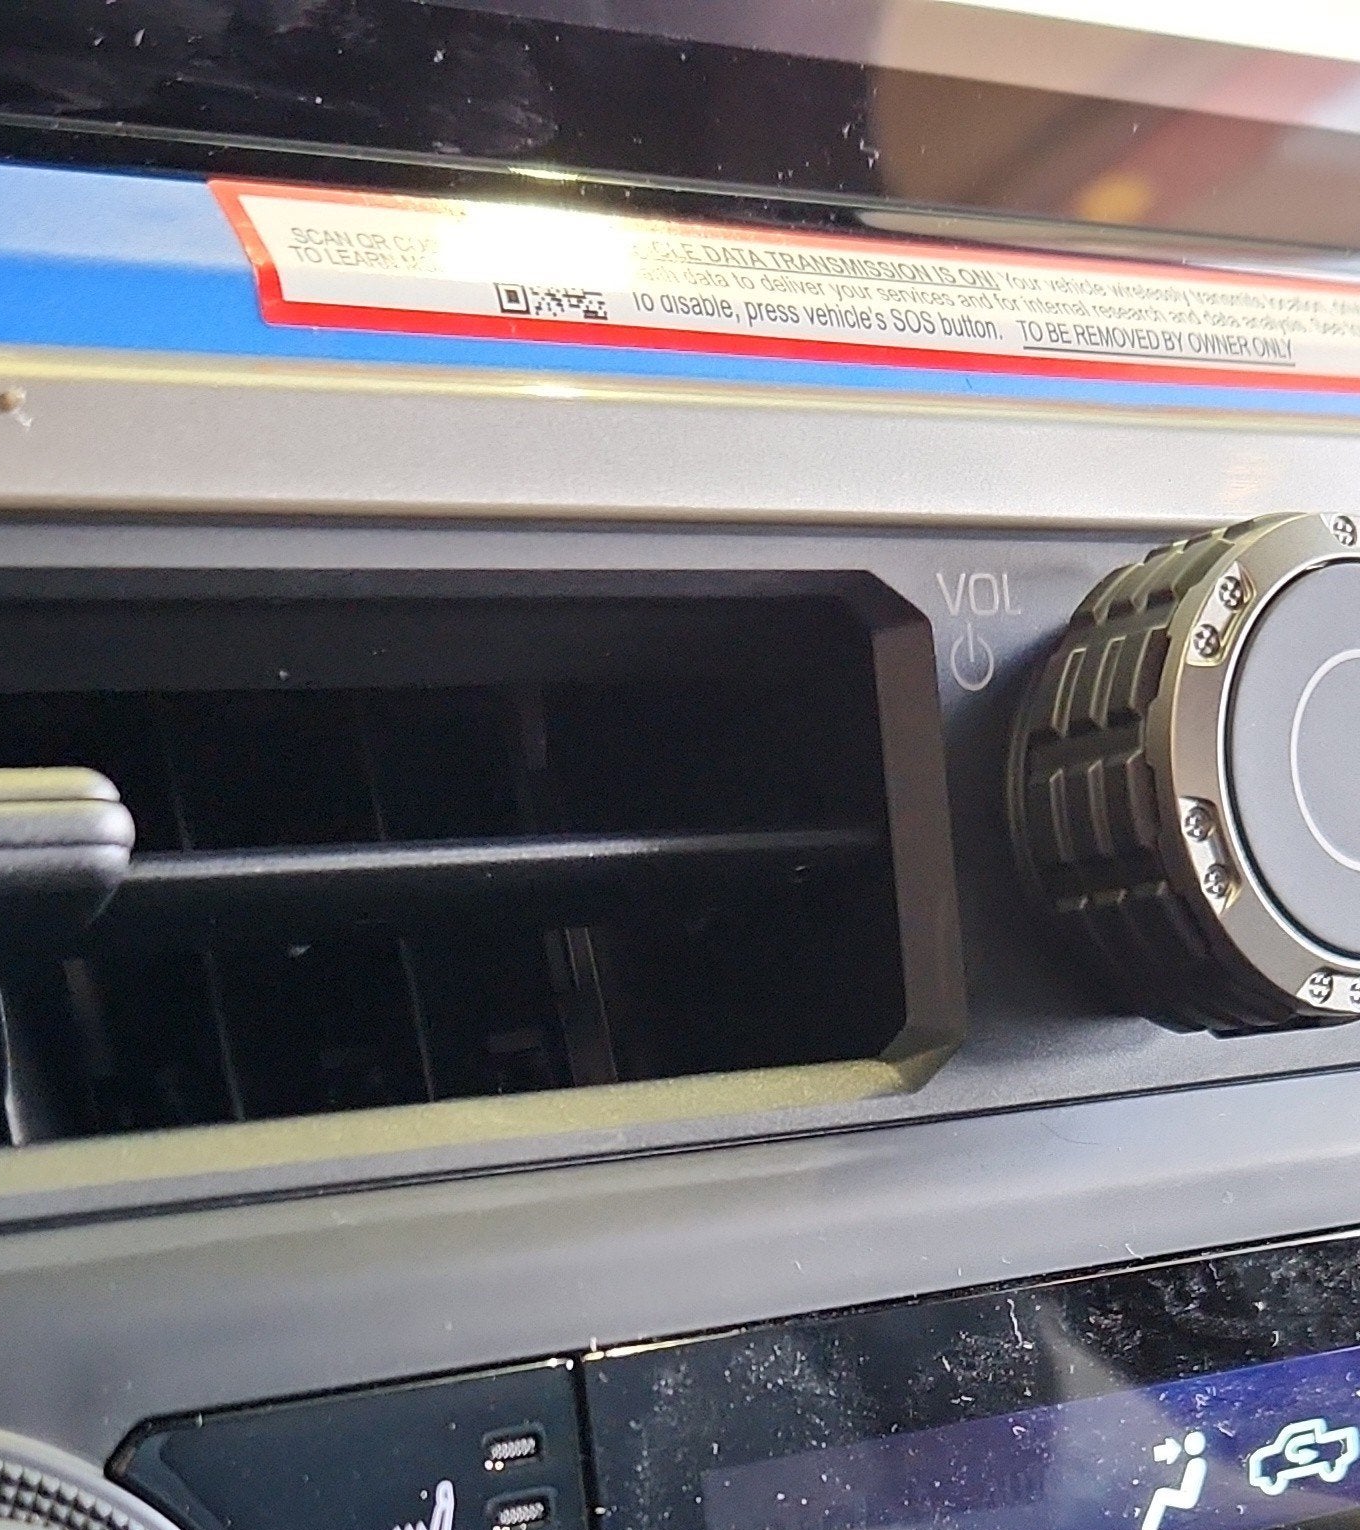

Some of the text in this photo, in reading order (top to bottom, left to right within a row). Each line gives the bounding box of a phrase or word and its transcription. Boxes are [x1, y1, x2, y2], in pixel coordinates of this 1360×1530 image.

[288, 246, 322, 263] TO
[291, 227, 353, 247] SCAN
[356, 233, 391, 250] OR
[701, 245, 764, 268] DATA
[764, 250, 934, 283] TRANSMISSION
[932, 265, 956, 284] IS
[958, 268, 999, 289] ON!
[999, 272, 1041, 292] Your
[1044, 278, 1107, 297] vehicle
[684, 267, 729, 288] data
[731, 272, 755, 290] to
[760, 274, 825, 296] deliver
[829, 283, 872, 301] your
[877, 286, 955, 306] services
[958, 292, 994, 309] and
[993, 294, 1020, 311] for
[1022, 297, 1091, 317] internal
[1091, 303, 1168, 323] research
[661, 294, 741, 323] disable,
[744, 300, 800, 327] press
[803, 303, 888, 331] vehicle's
[890, 308, 936, 334] SOS
[938, 312, 1003, 340] button.
[1016, 320, 1043, 342] TO
[1045, 322, 1072, 345] BE
[1073, 325, 1160, 350] REMOVED
[1161, 331, 1184, 353] BY
[1188, 332, 1251, 356] OWNER
[1252, 337, 1292, 359] ONLY
[936, 573, 1021, 616] VOL
